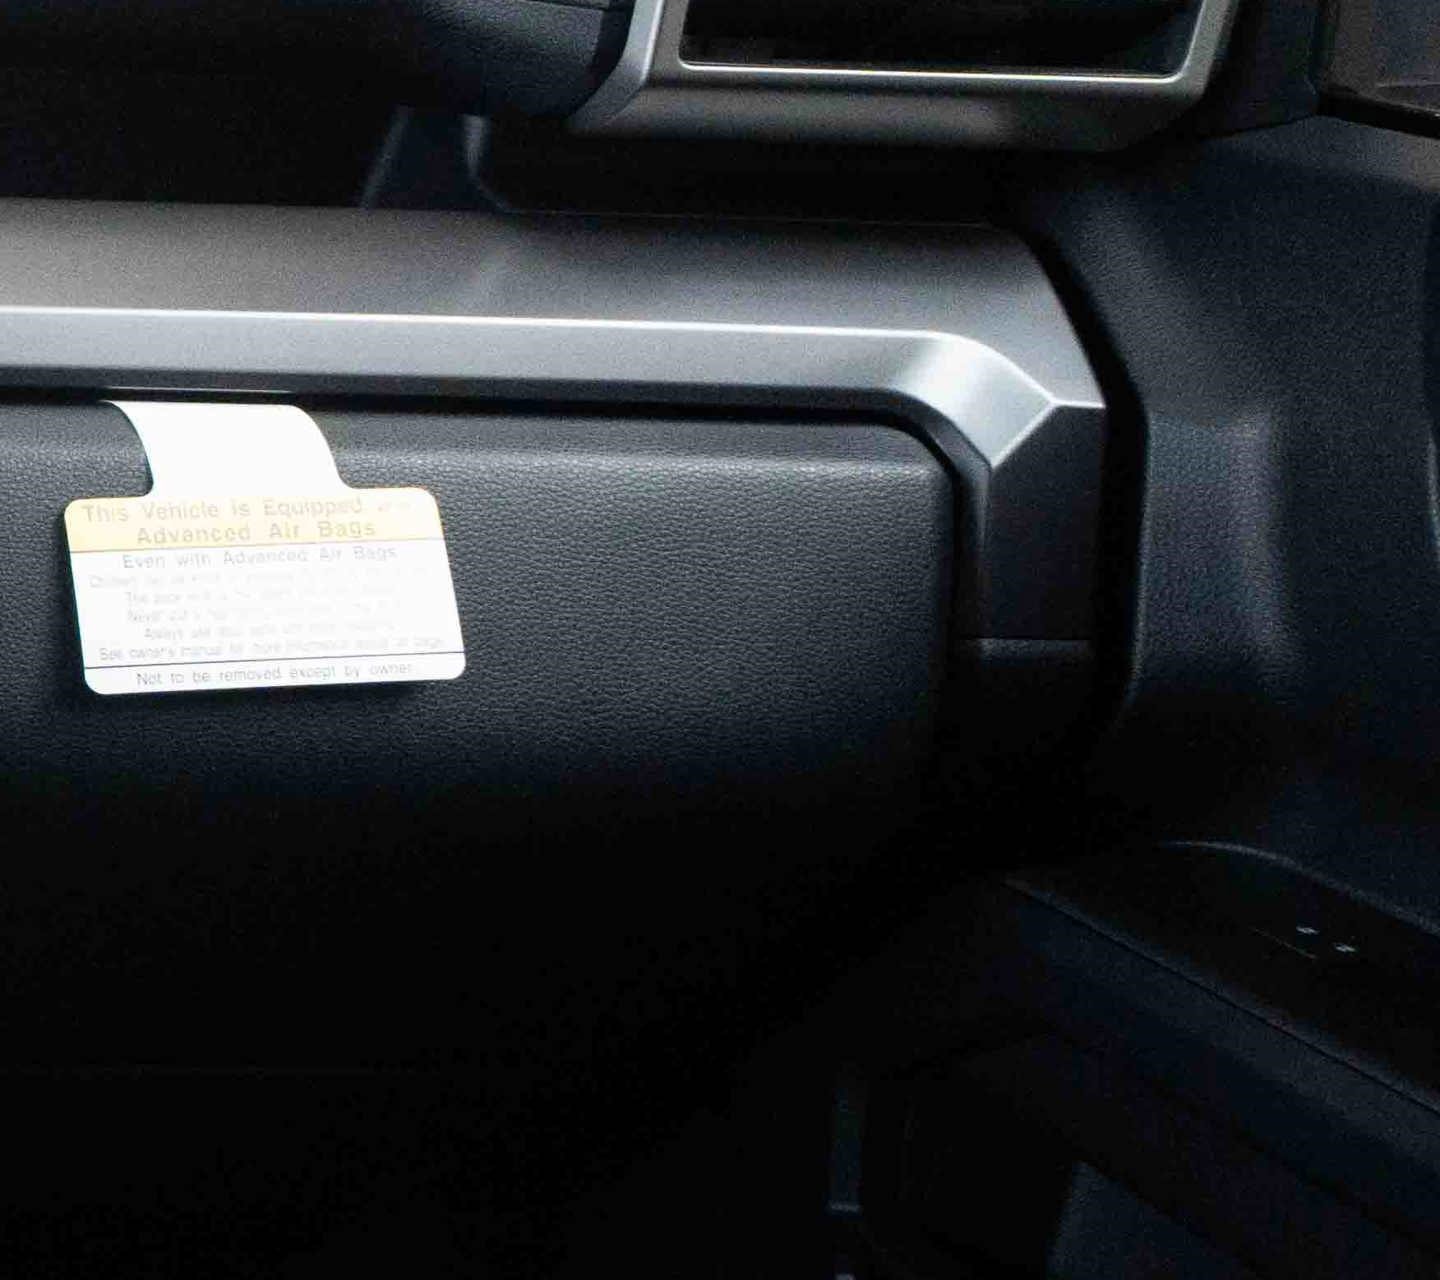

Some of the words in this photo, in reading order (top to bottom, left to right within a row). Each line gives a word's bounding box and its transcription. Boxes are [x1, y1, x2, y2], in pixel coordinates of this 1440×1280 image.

[81, 504, 130, 523] This
[141, 501, 220, 521] Vehicle
[232, 500, 251, 517] is
[264, 497, 363, 518] Equipped
[136, 524, 251, 544] Advanced
[269, 522, 300, 539] Air
[317, 520, 377, 539] Bags
[122, 554, 166, 569] Even
[223, 549, 310, 565] Advanced
